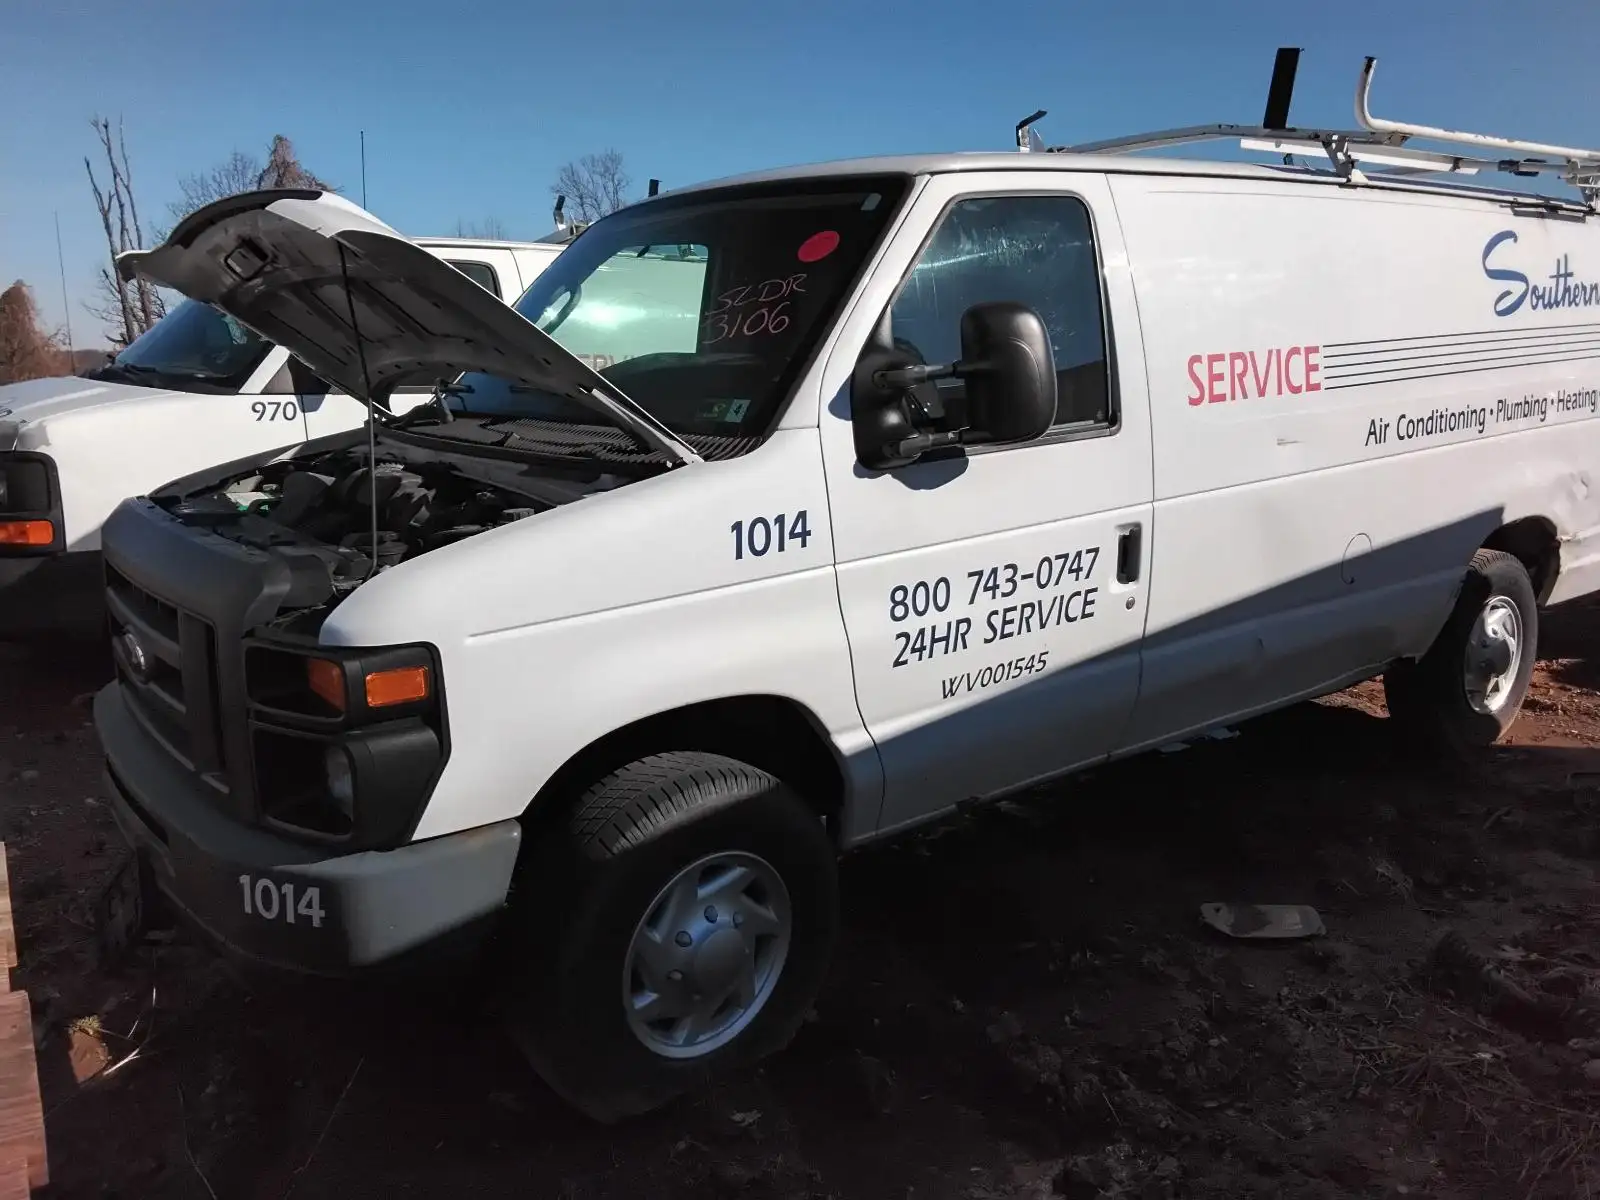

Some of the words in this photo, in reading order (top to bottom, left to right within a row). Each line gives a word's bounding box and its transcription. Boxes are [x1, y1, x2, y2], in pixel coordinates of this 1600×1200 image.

[1482, 229, 1600, 317] Southern
[702, 302, 790, 344] 3106
[1187, 345, 1321, 407] SERVICE
[251, 401, 297, 421] 970
[1365, 418, 1390, 446] Air
[1396, 404, 1486, 441] Conditioning
[1496, 394, 1548, 423] Plumbing
[1556, 386, 1597, 413] Heating
[730, 509, 812, 560] 1014
[889, 576, 950, 622] 800
[967, 546, 1100, 605] 743-0747
[892, 617, 972, 668] 24HR
[983, 587, 1098, 644] SERVICE
[941, 651, 1049, 699] WV001545
[239, 874, 326, 928] 1014
